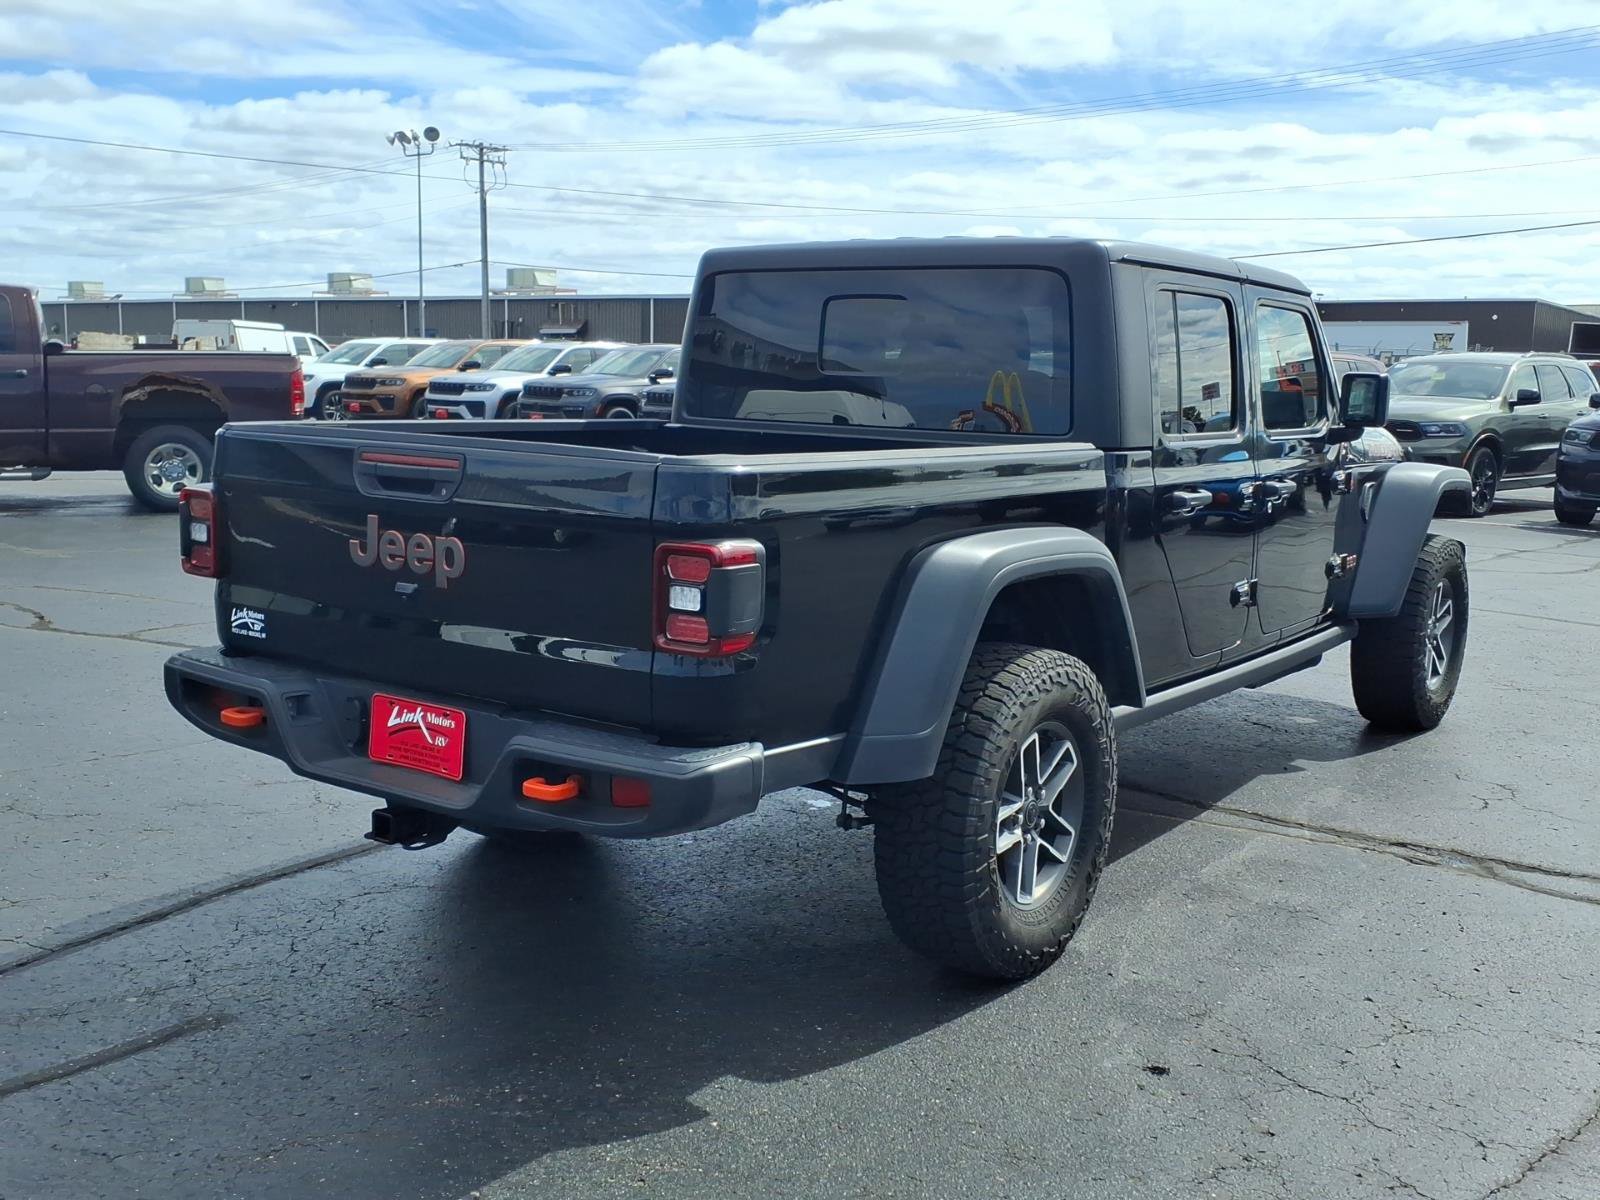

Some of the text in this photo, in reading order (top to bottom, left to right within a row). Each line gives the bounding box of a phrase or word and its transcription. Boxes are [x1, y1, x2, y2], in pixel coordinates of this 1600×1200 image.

[349, 514, 465, 589] Jeep
[248, 611, 264, 620] Motors
[387, 706, 456, 744] Link Motors
[435, 736, 448, 747] RV
